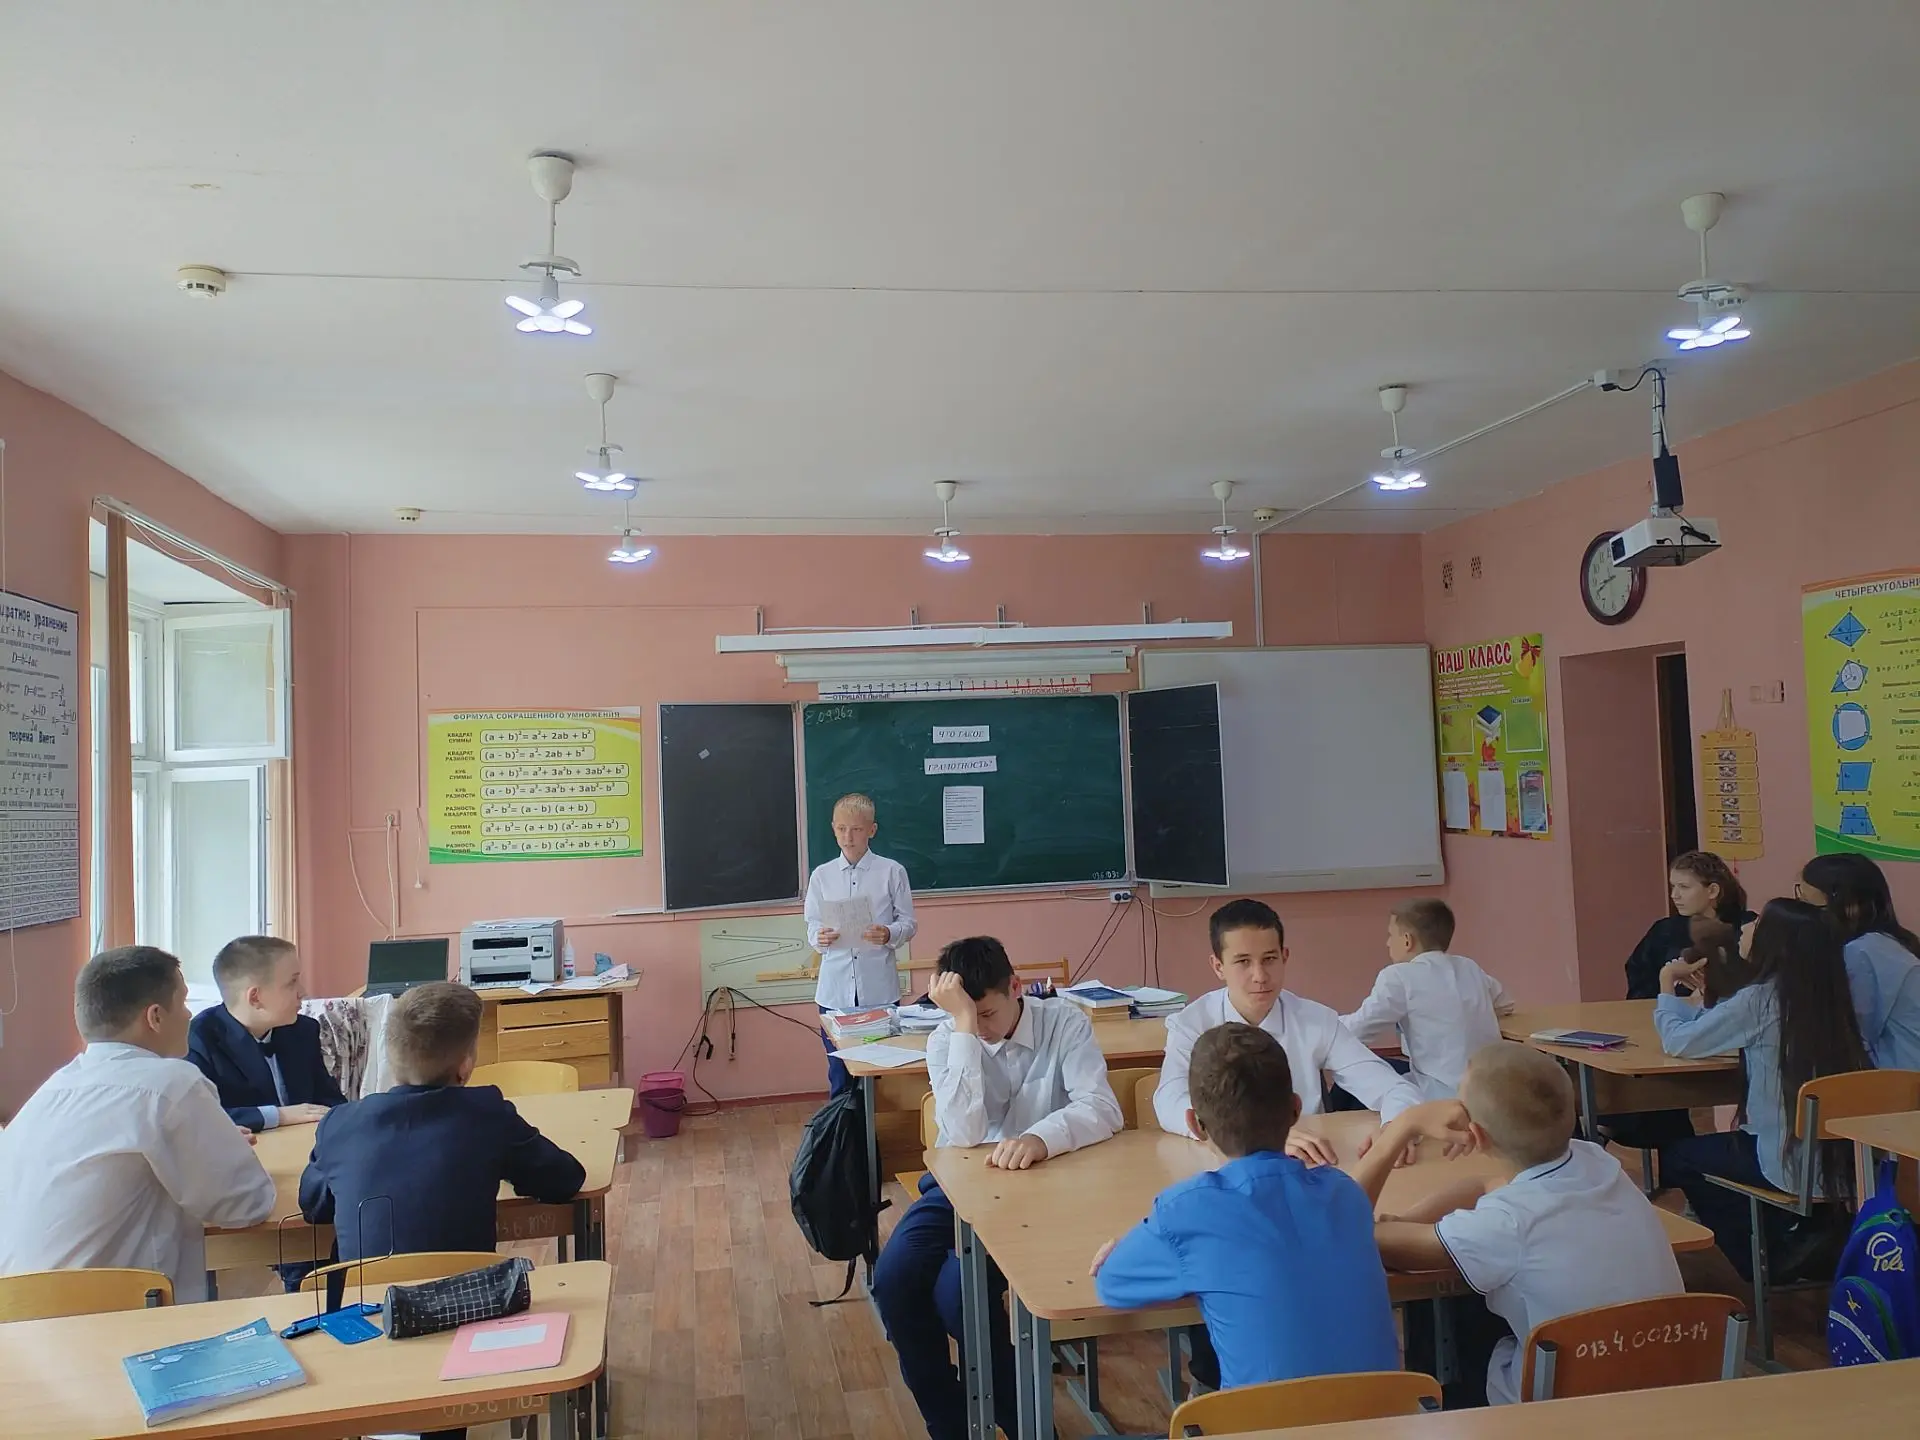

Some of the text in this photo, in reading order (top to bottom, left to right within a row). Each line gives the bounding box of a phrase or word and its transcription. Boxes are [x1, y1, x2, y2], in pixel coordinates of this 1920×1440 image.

[1437, 641, 1513, 675] НАШ КЛАСС
[453, 712, 494, 721] ФОРМУЛА
[566, 710, 620, 720] УМНОЖЕНИЯ
